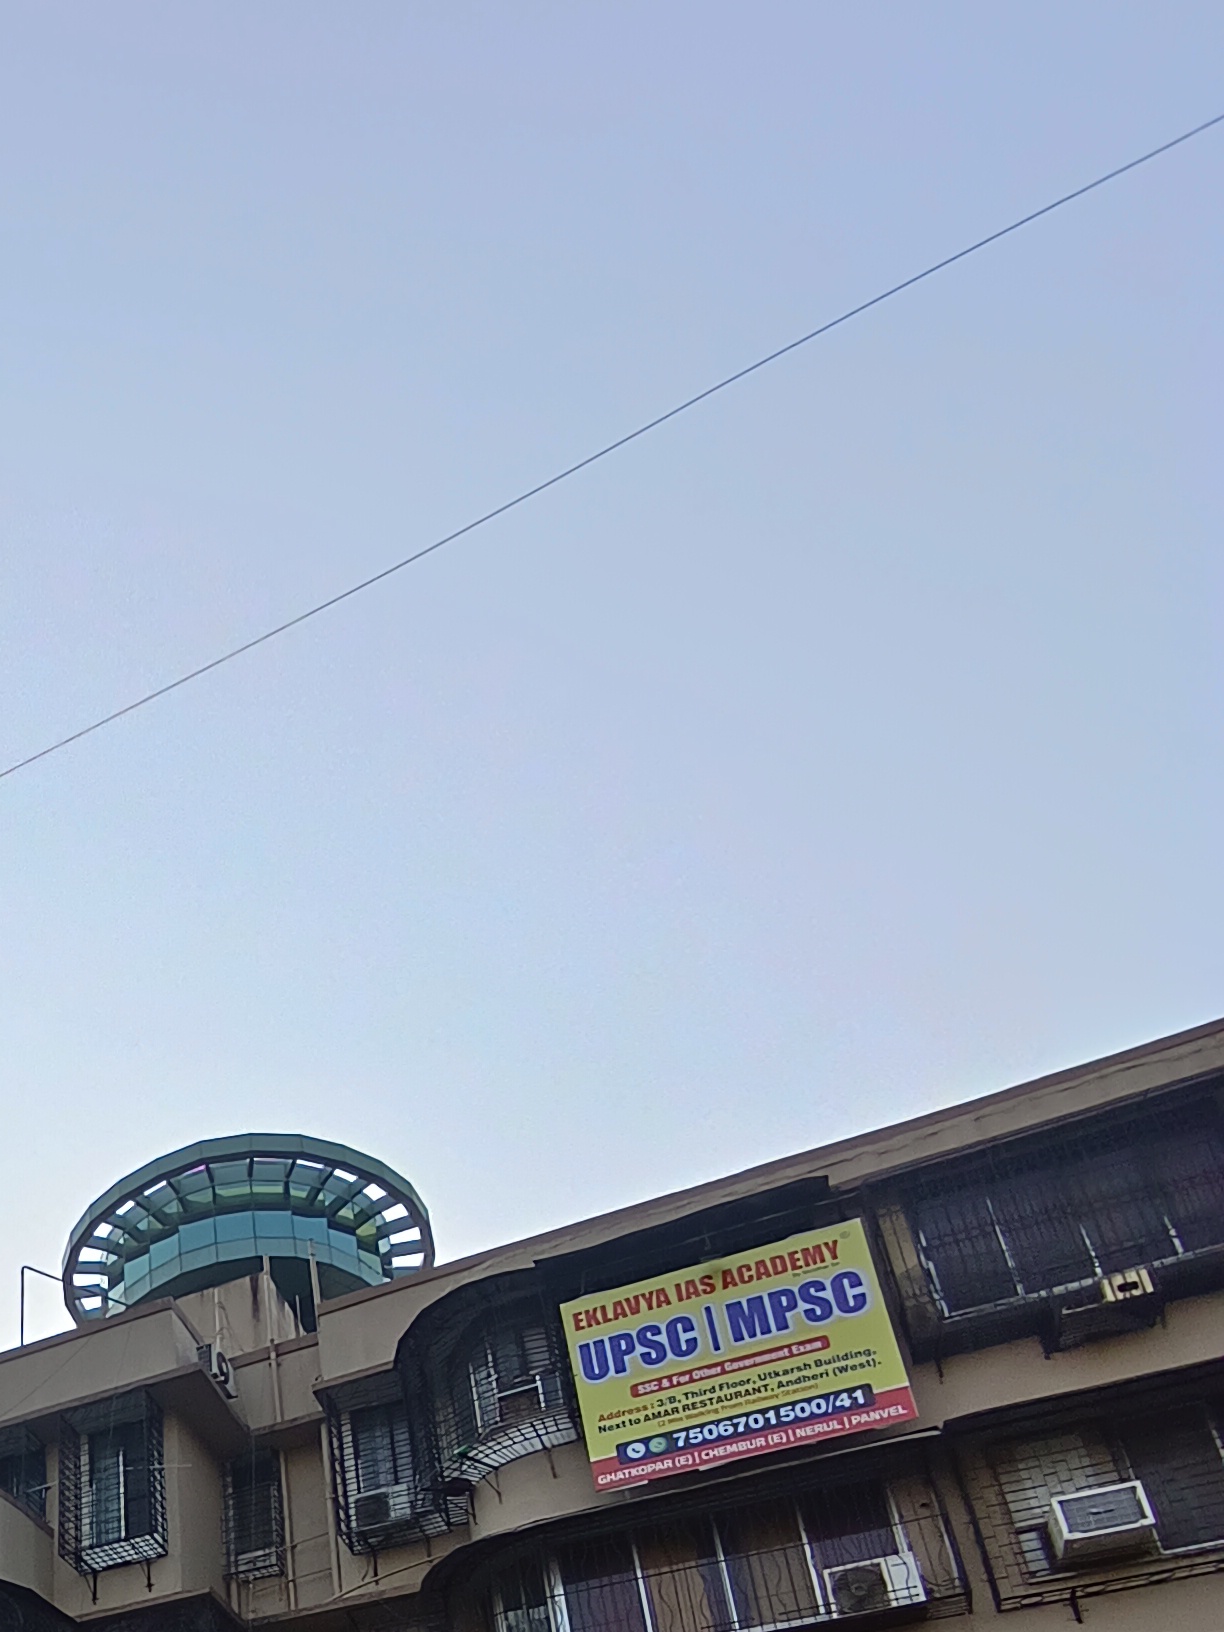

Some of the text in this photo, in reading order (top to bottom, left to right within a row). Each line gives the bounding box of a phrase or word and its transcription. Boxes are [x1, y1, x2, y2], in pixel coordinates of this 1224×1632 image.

[572, 1239, 839, 1332] EKLAVYA IAS ACADEMY
[578, 1270, 868, 1381] UPSC MPSC
[598, 1421, 626, 1434] Next
[629, 1416, 642, 1426] to
[643, 1407, 681, 1423] AMAR
[682, 1384, 775, 1413] RESTAURANT,
[777, 1370, 830, 1390] Andheri
[637, 1381, 660, 1394] SSC
[692, 1365, 722, 1380] Other
[725, 1347, 790, 1371] Government
[683, 1386, 717, 1401] Third
[718, 1377, 757, 1392] Floor,
[757, 1362, 812, 1382] Utkarsh
[597, 1404, 908, 1485] GHATKOPAR (E) CHEMBUR (E) NERUL PANVEL
[672, 1389, 865, 1447] 7506701500/41
